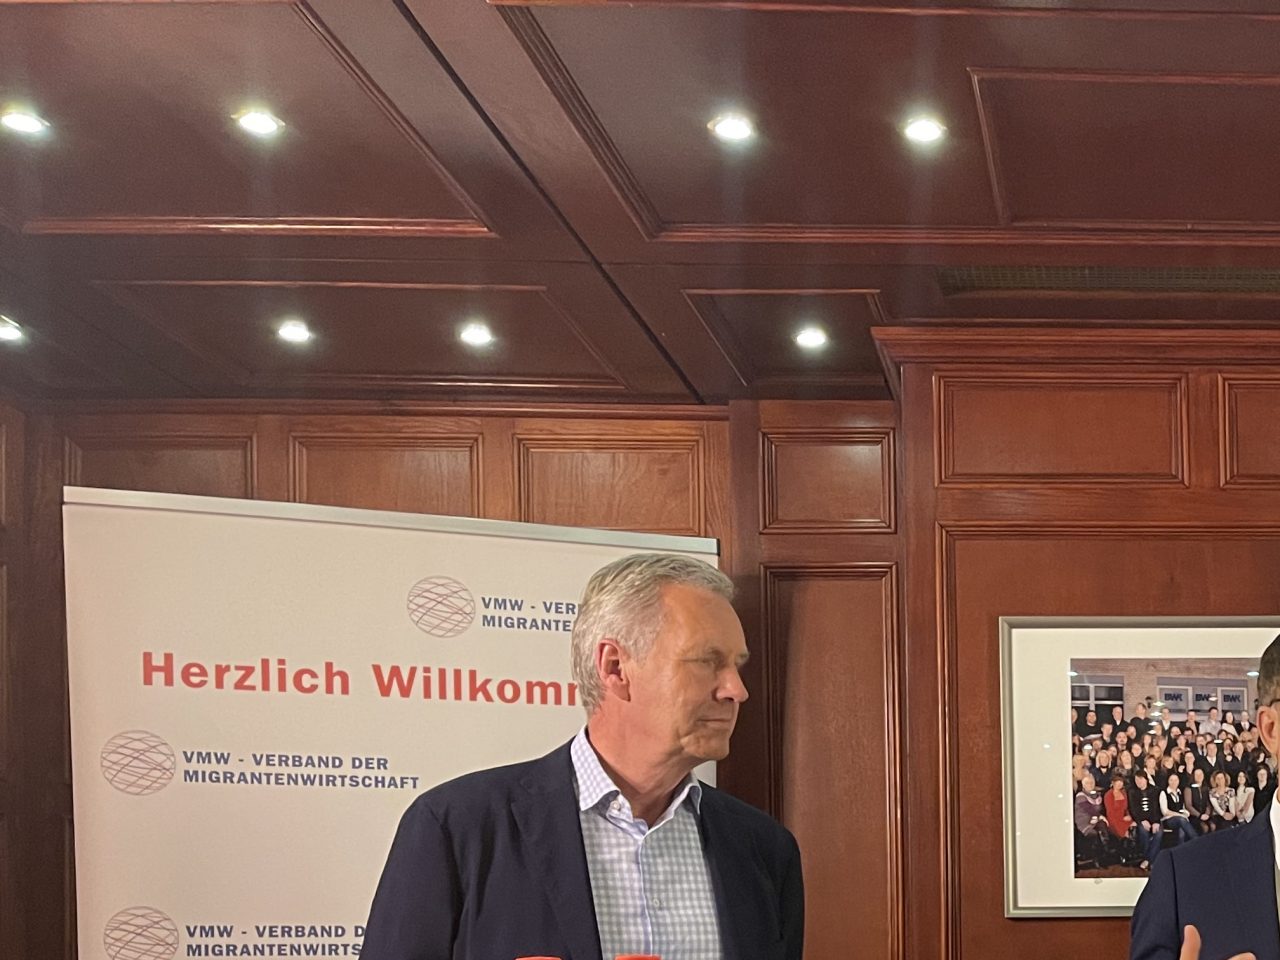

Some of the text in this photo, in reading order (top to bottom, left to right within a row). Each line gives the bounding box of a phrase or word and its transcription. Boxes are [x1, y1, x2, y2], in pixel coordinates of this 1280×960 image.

[481, 597, 523, 611] VMW
[543, 601, 582, 615] VER
[482, 615, 572, 632] MIGRANTE
[143, 652, 349, 695] Herzlich
[182, 751, 230, 765] VMW
[251, 753, 343, 769] VERBAND
[351, 757, 389, 770] DER
[183, 770, 419, 789] MIGRANTENWIRTSCHAFT
[185, 925, 234, 938] VMW
[255, 925, 346, 938] VERBAND
[186, 943, 361, 957] MIGRANTENWIRTS
